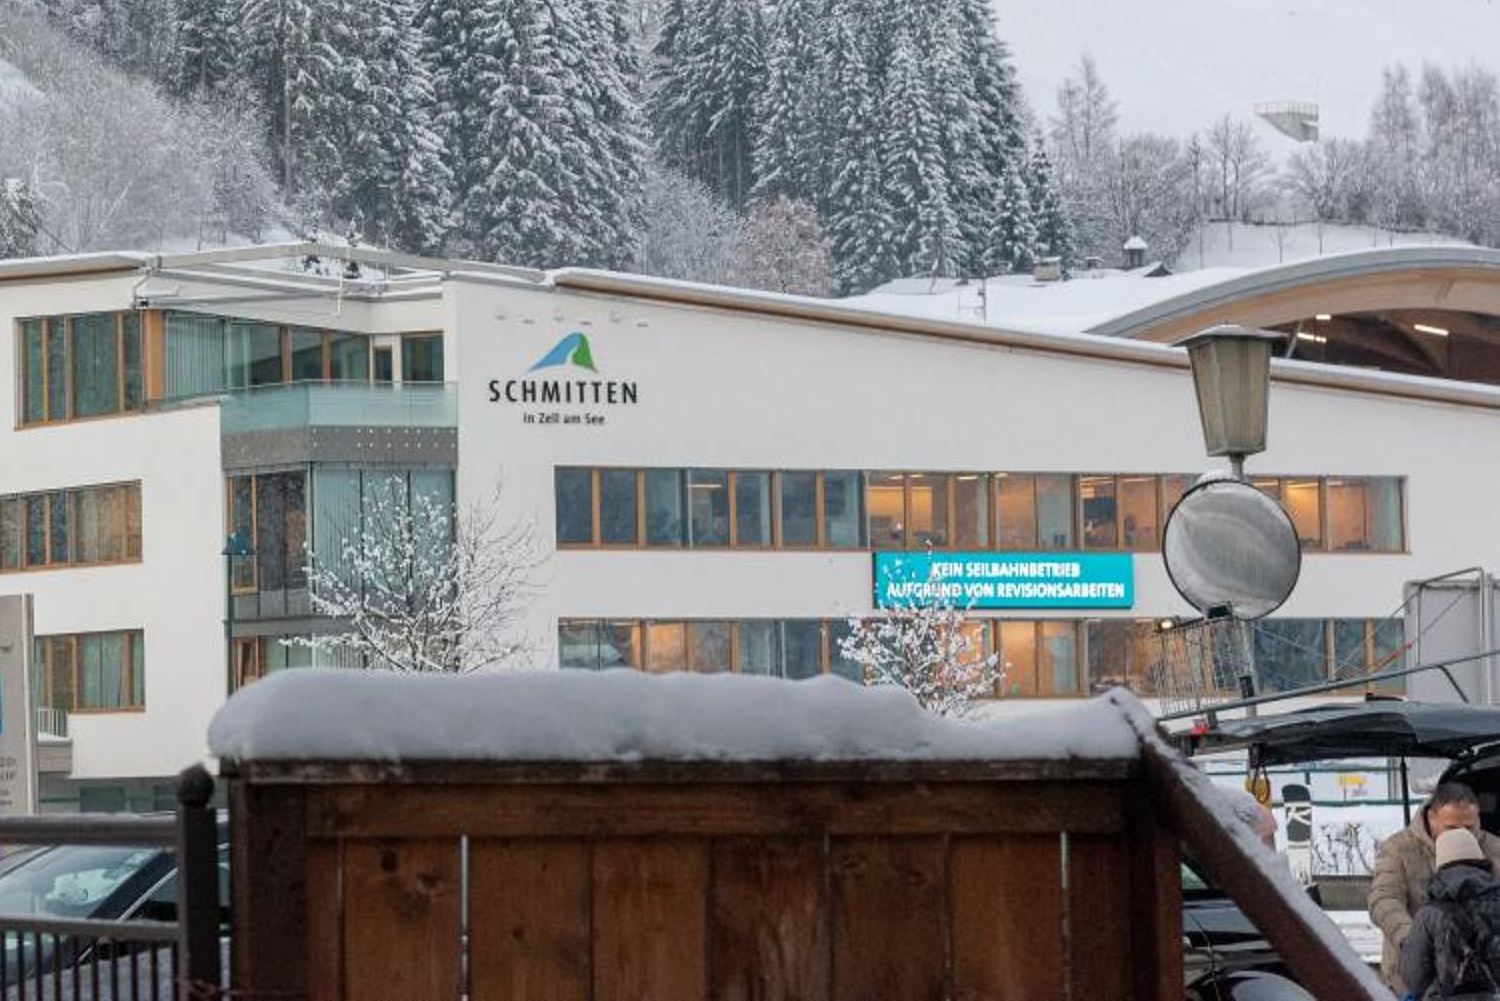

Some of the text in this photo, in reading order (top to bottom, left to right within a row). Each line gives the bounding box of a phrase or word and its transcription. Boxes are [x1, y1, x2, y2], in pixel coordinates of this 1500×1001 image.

[488, 379, 638, 404] SCHMITTEN
[538, 412, 560, 424] Zell
[563, 413, 581, 424] am
[585, 412, 605, 425] See
[931, 562, 1080, 577] KEIN SEILBAHNBETRIEB
[886, 583, 1125, 598] AUFGRUND VON REVISIONSARBEITEN
